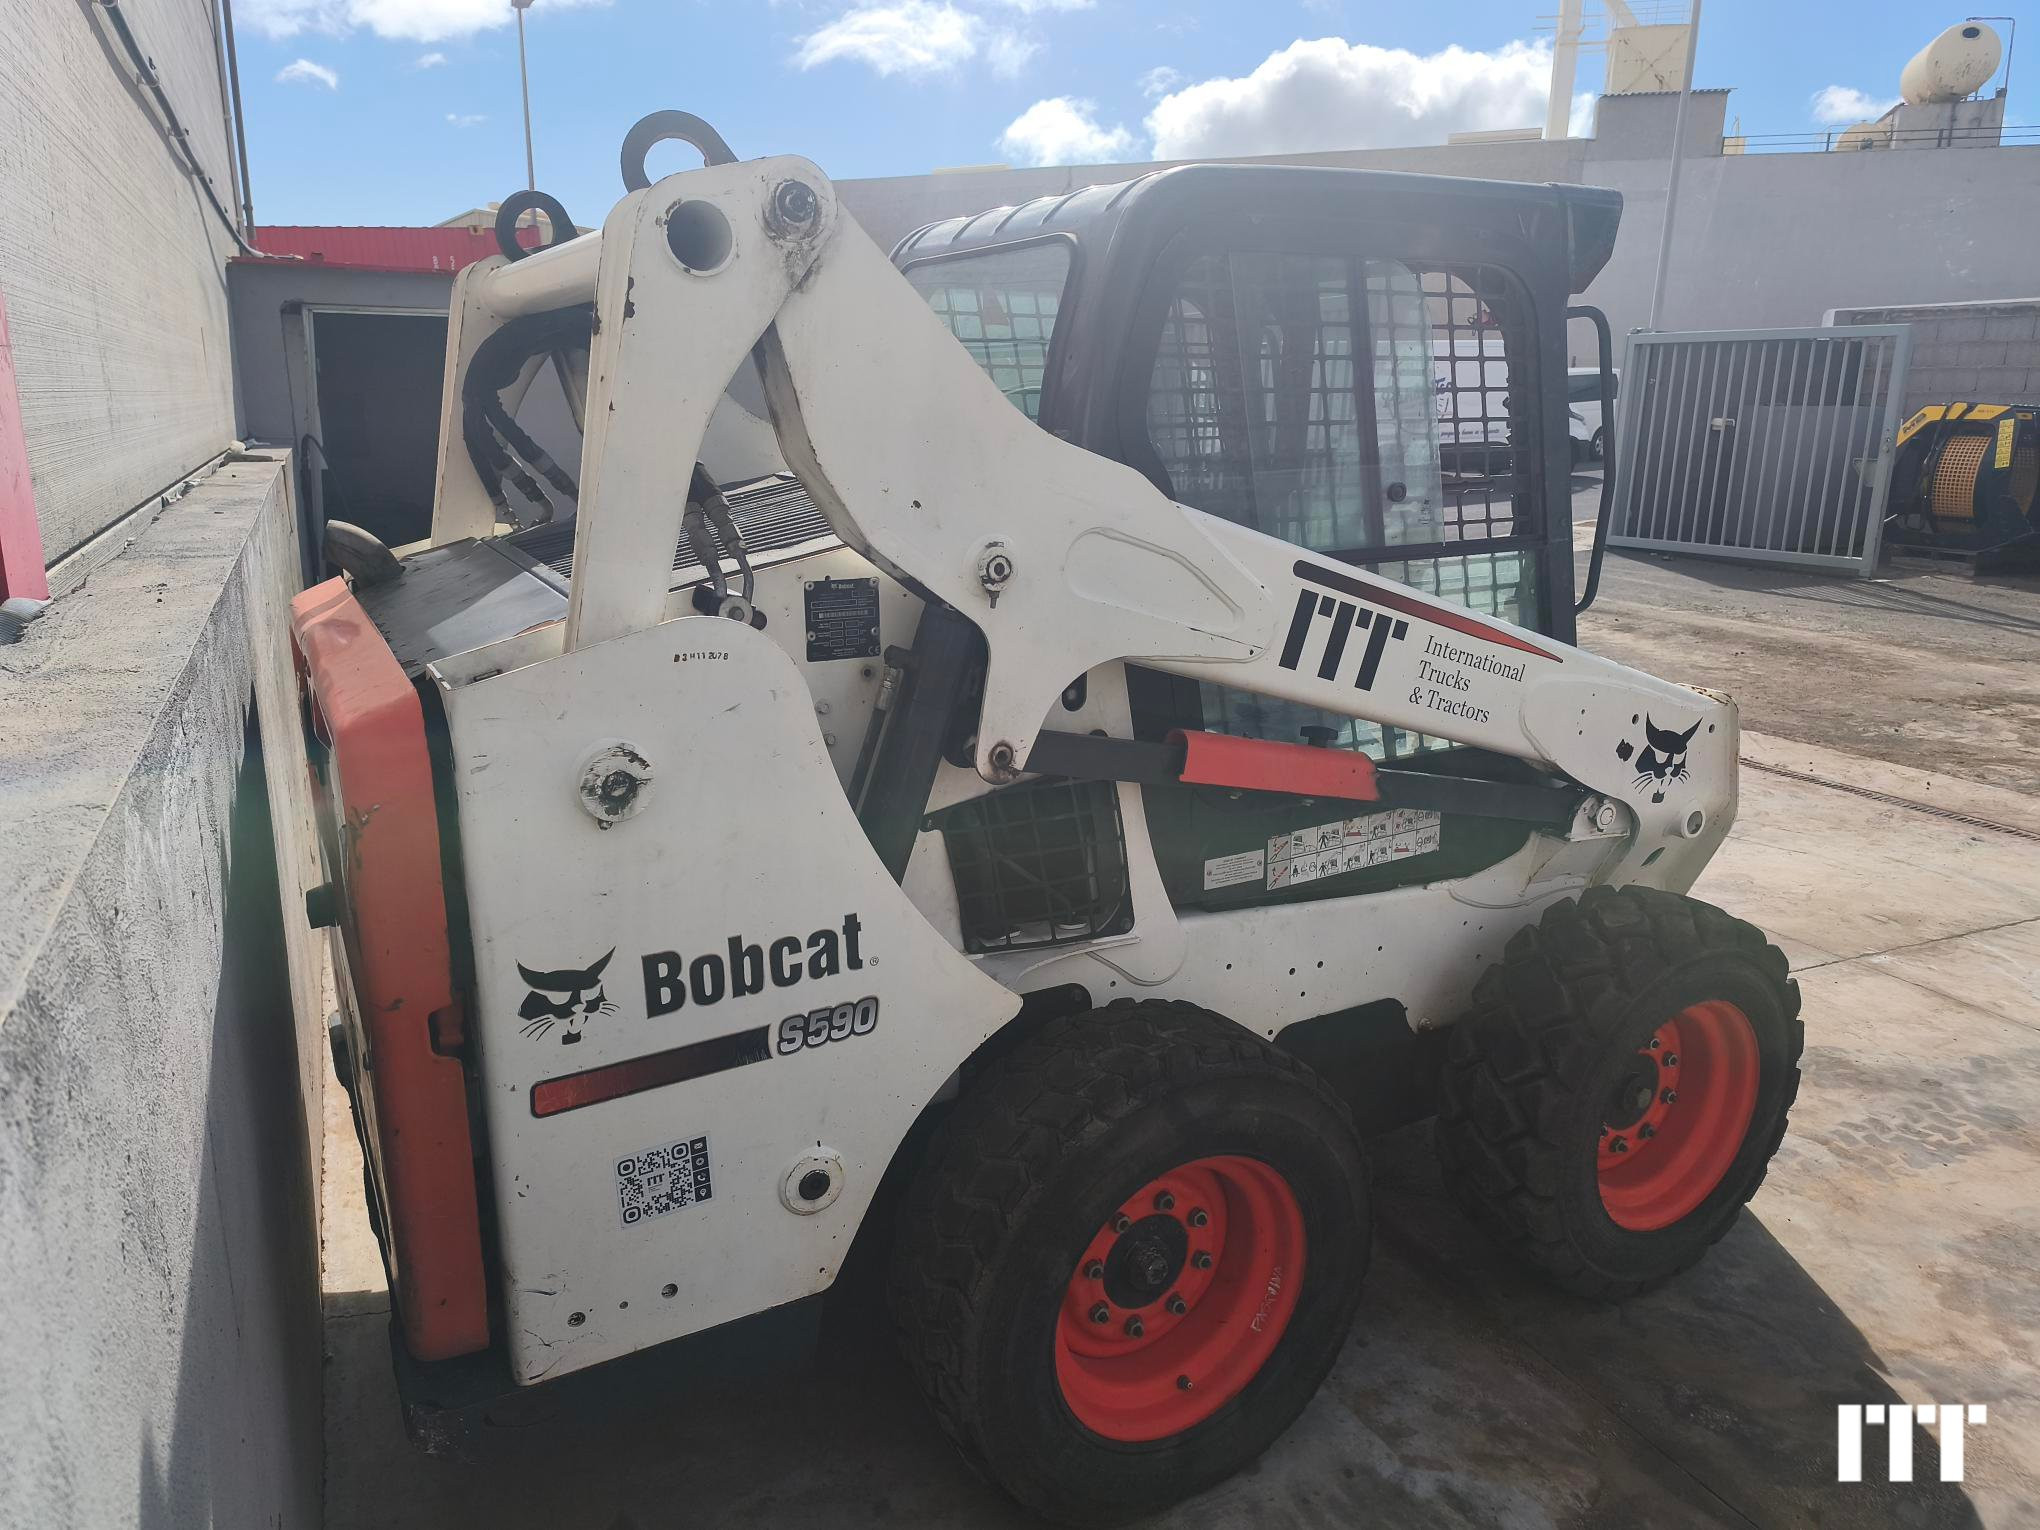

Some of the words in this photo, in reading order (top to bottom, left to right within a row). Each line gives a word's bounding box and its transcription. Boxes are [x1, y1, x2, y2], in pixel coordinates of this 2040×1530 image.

[1418, 659, 1471, 692] Trucks
[1423, 634, 1526, 683] International
[1408, 686, 1423, 704] &
[1427, 689, 1490, 724] Tractors
[641, 913, 863, 1019] Bobcat
[777, 994, 880, 1056] S590
